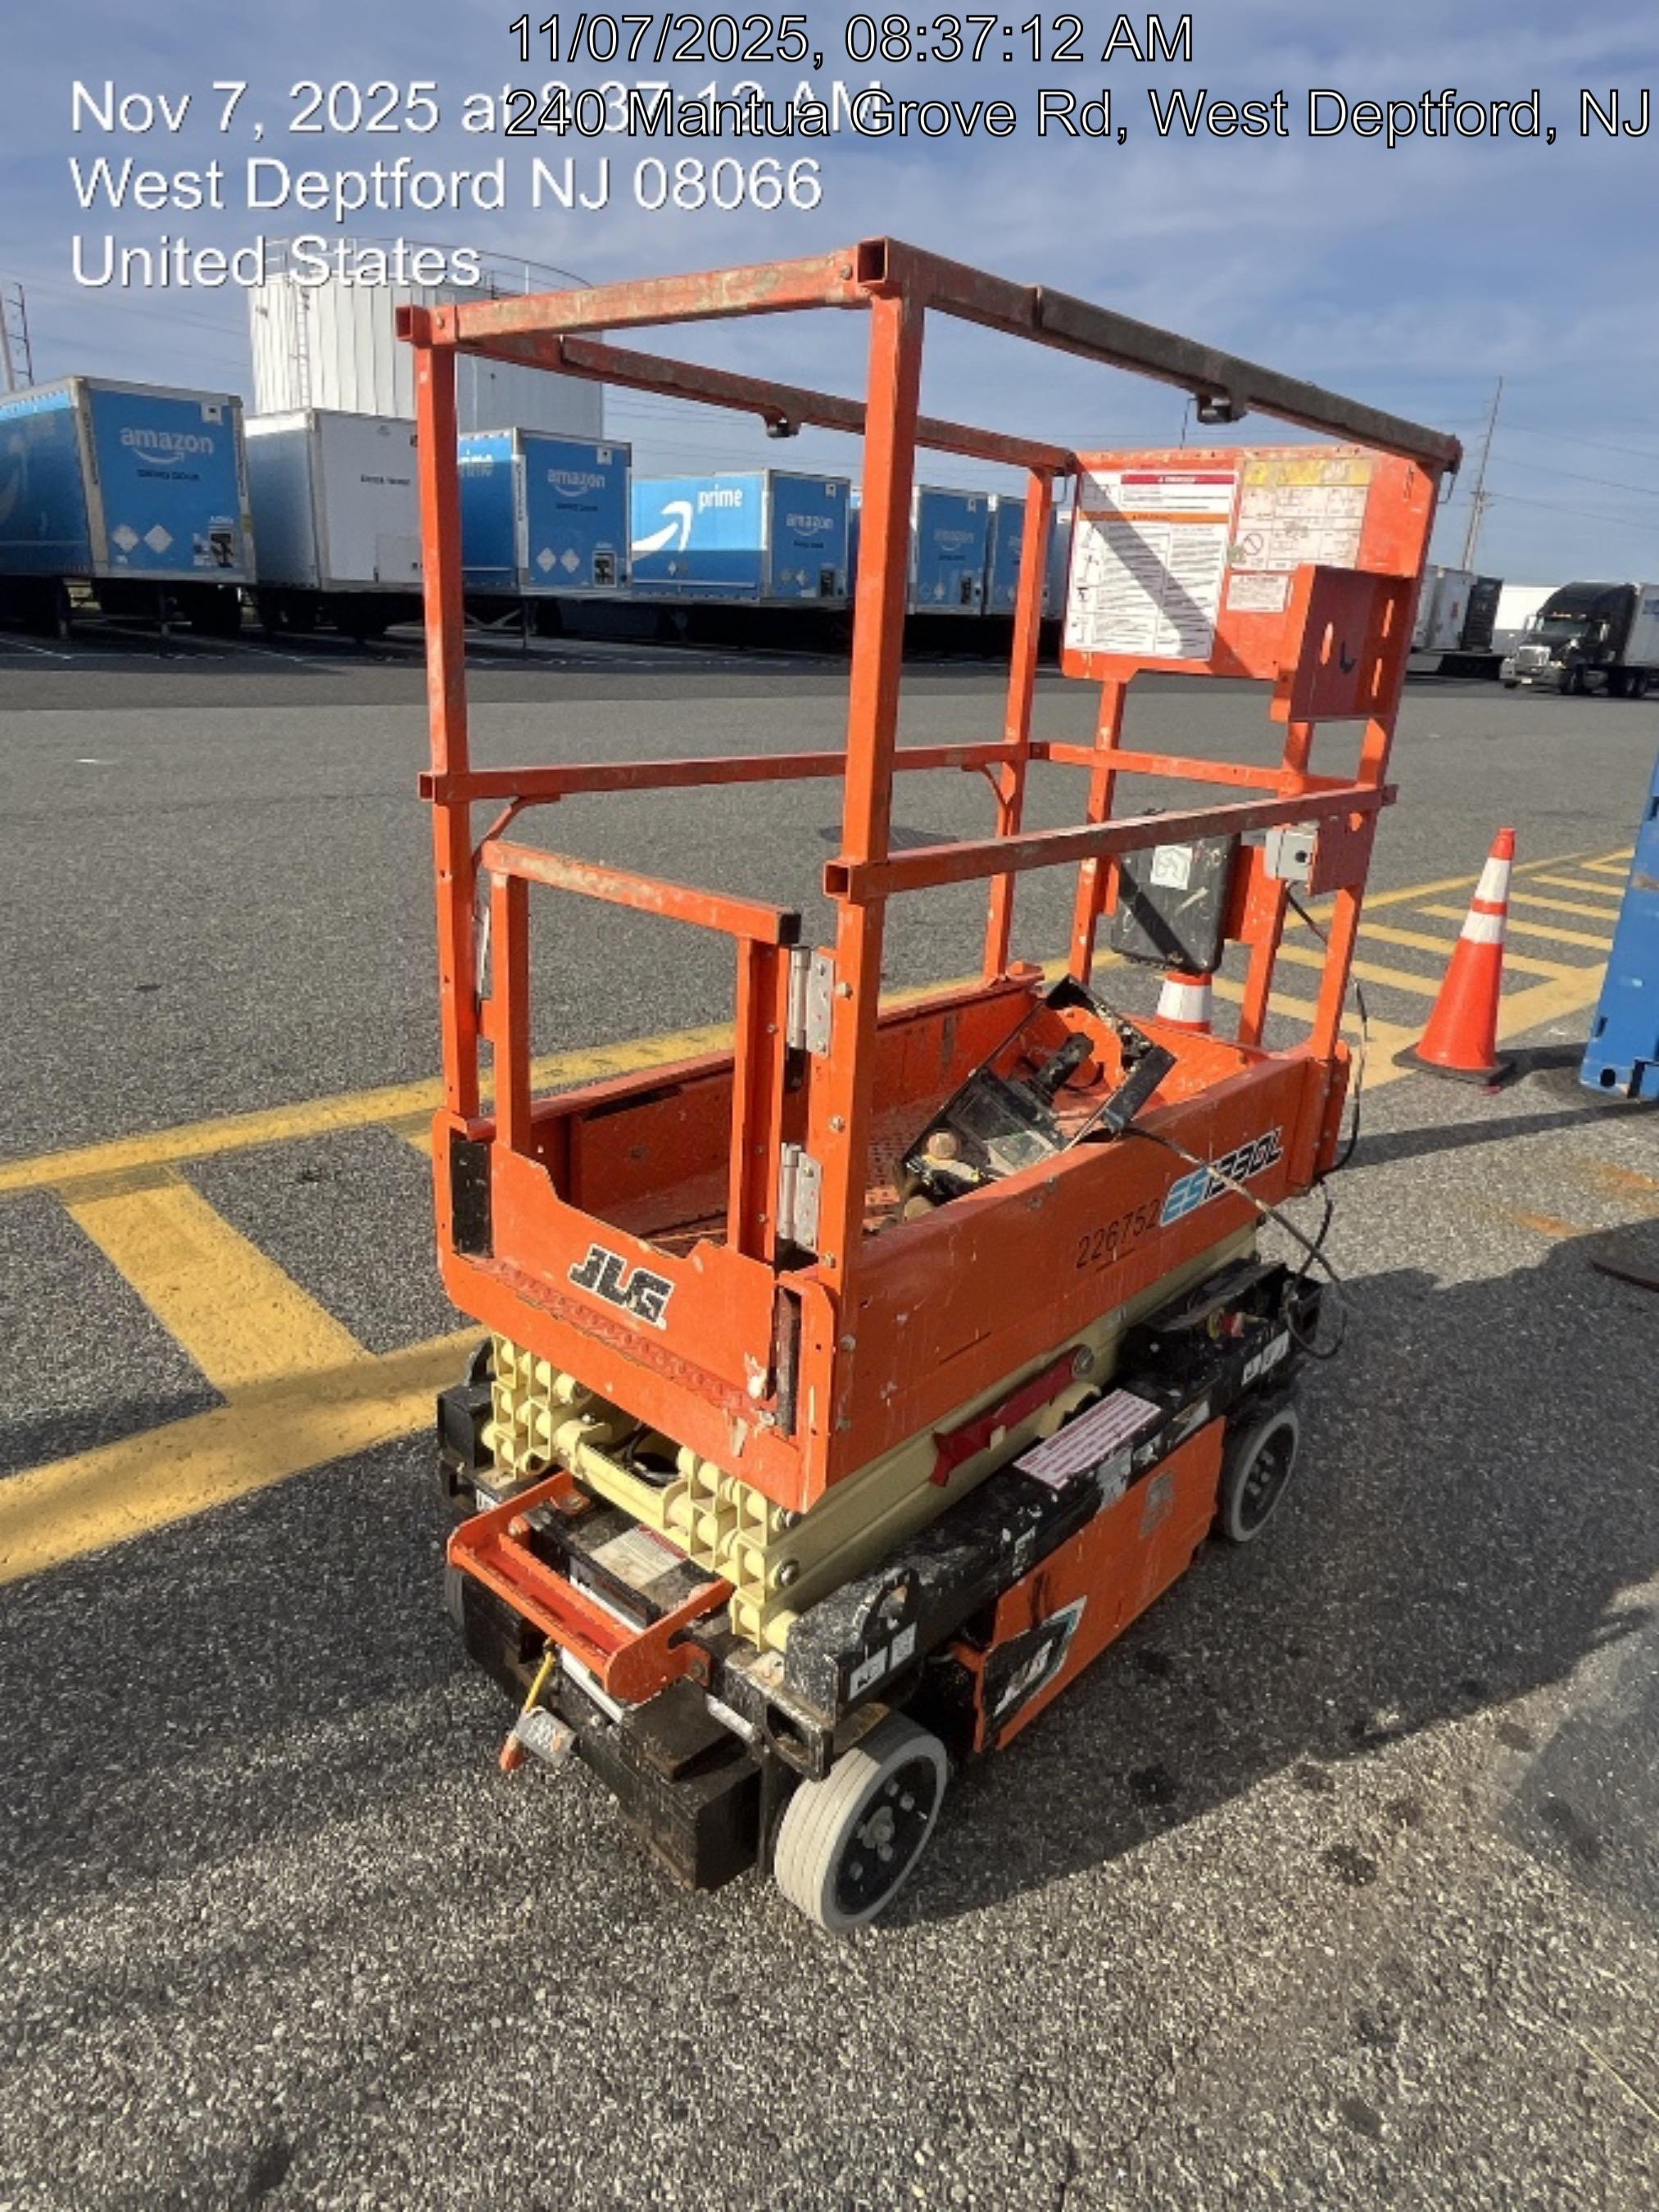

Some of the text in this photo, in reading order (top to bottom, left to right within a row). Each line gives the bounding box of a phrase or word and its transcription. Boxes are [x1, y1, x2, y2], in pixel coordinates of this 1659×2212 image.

[120, 427, 214, 456] amazon
[547, 469, 605, 489] amazon
[698, 484, 743, 514] prime
[1077, 1199, 1161, 1268] 226752
[567, 1242, 677, 1328] JLG
